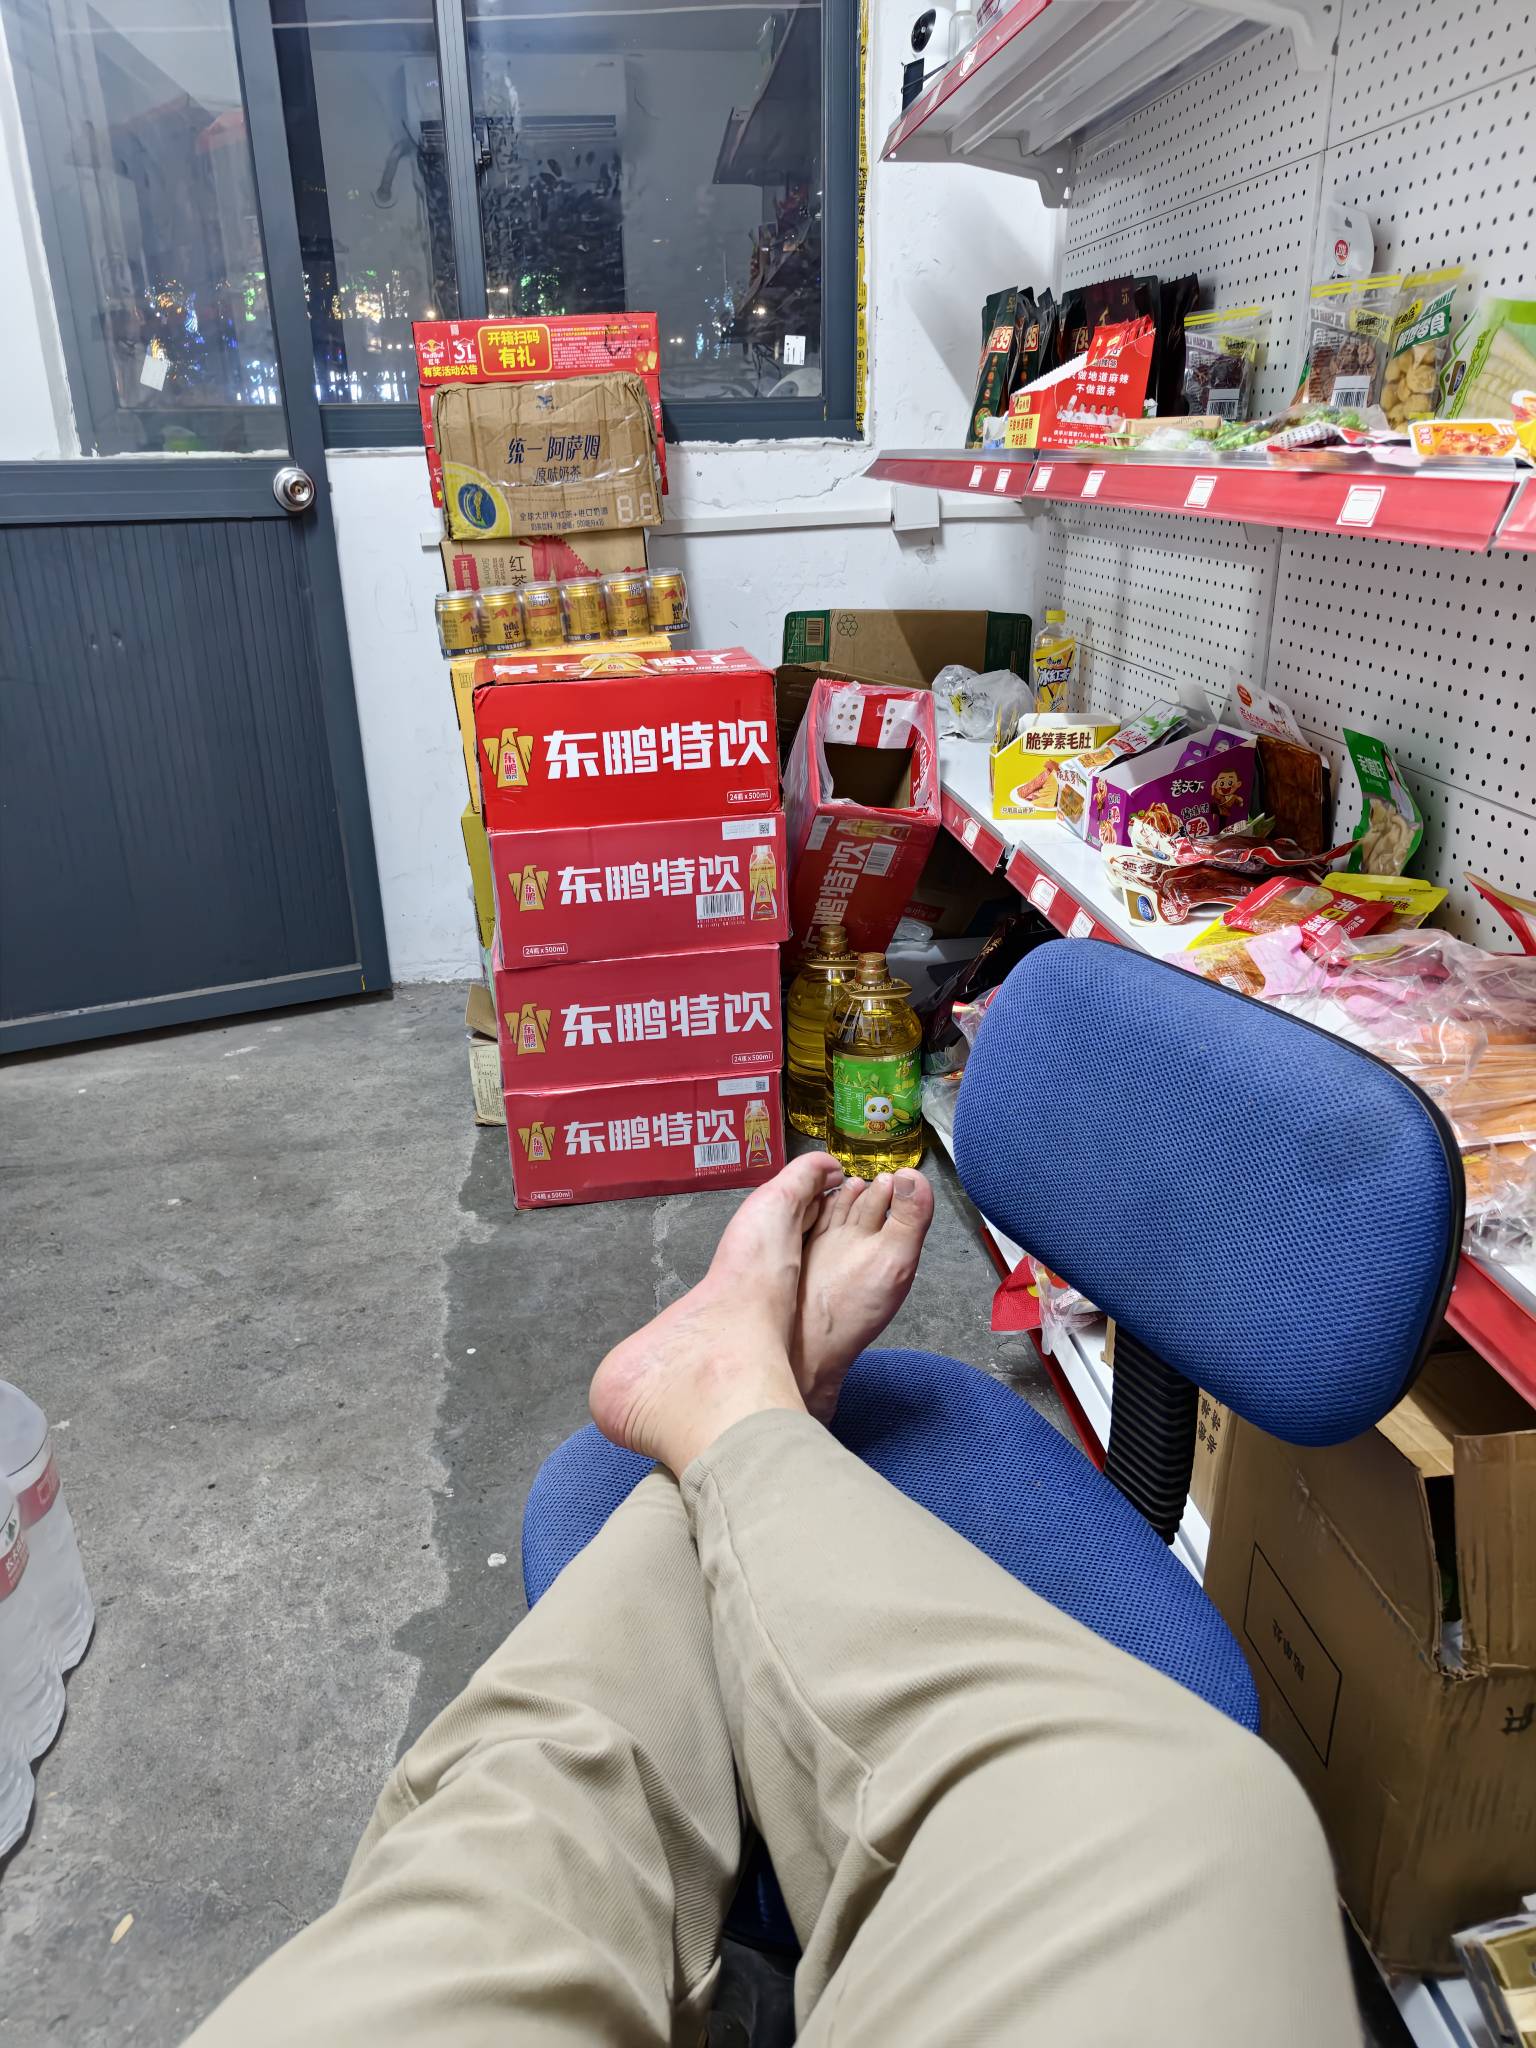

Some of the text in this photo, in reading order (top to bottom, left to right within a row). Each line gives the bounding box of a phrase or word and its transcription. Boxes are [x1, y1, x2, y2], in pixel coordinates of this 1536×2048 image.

[487, 330, 540, 346] 开箱扫码
[498, 346, 536, 368] 有礼
[422, 364, 478, 378] 有奖活动公告
[1073, 370, 1130, 384] 做地道麻辣
[534, 465, 582, 485] 原味奶茶
[543, 718, 771, 780] 东鹏特饮
[1025, 732, 1092, 750] 脆笋素毛肚
[557, 854, 742, 905] 东鹏特饮
[545, 945, 565, 953] 500ml
[561, 991, 772, 1047] 东鹏特饮
[563, 1108, 737, 1156] 东鹏特饮
